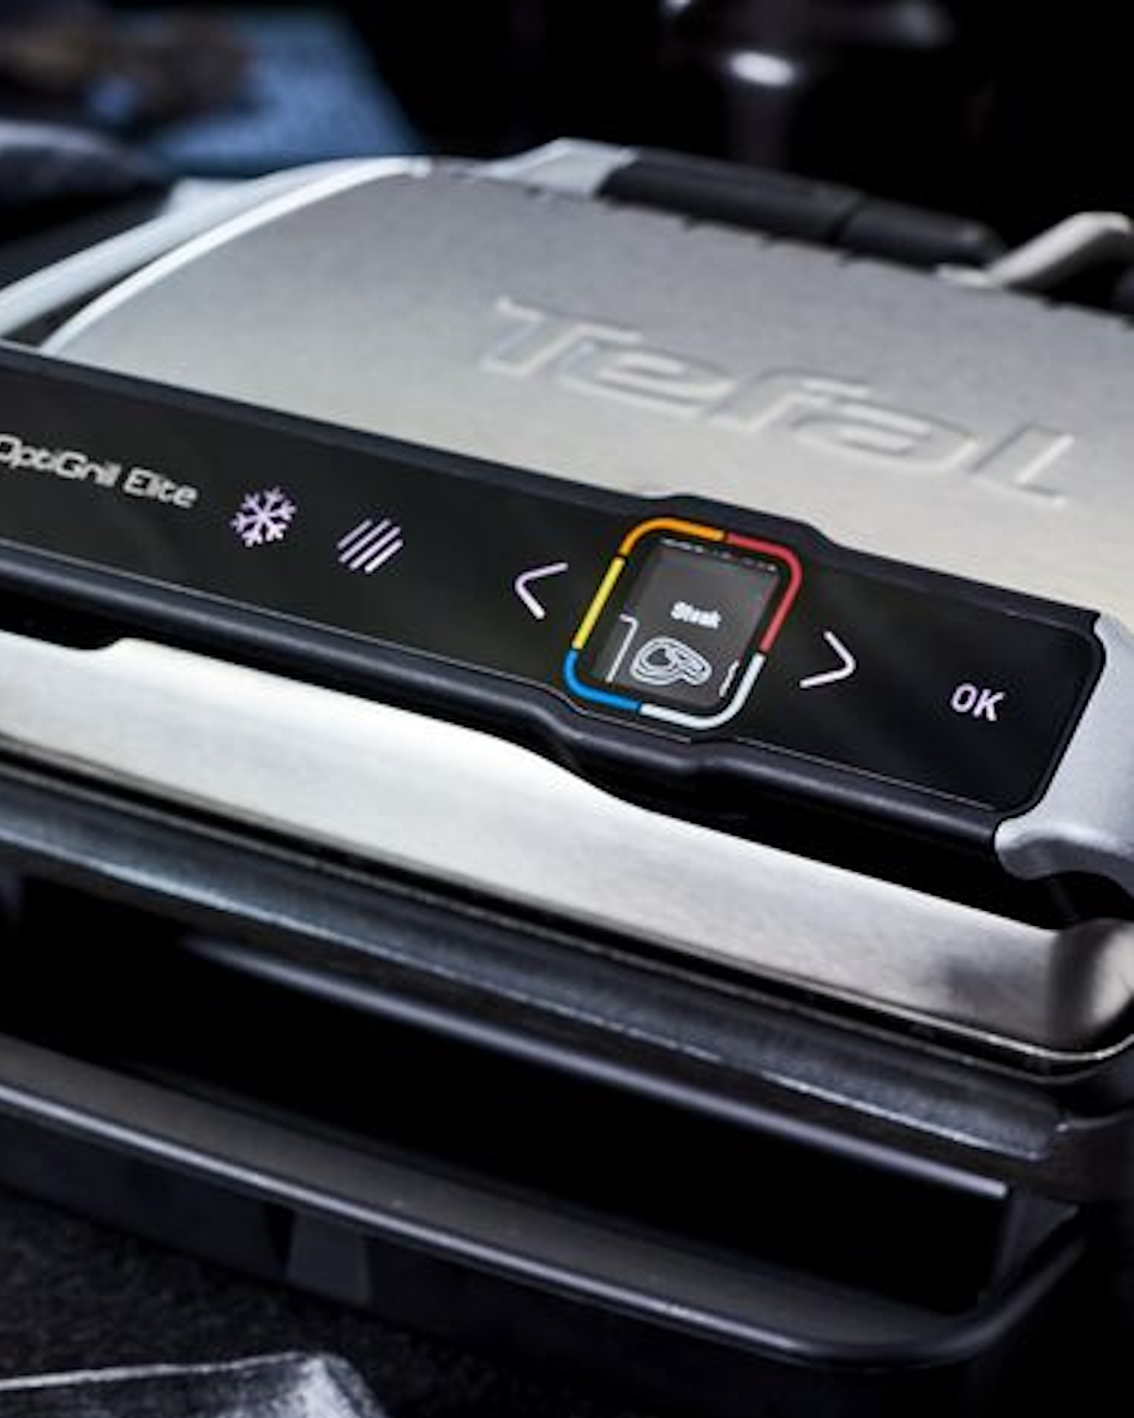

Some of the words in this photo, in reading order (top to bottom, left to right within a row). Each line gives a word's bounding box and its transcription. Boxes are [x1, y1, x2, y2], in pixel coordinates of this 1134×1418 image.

[122, 467, 198, 509] Elite
[670, 600, 723, 631] Steak
[950, 683, 1005, 722] OK
